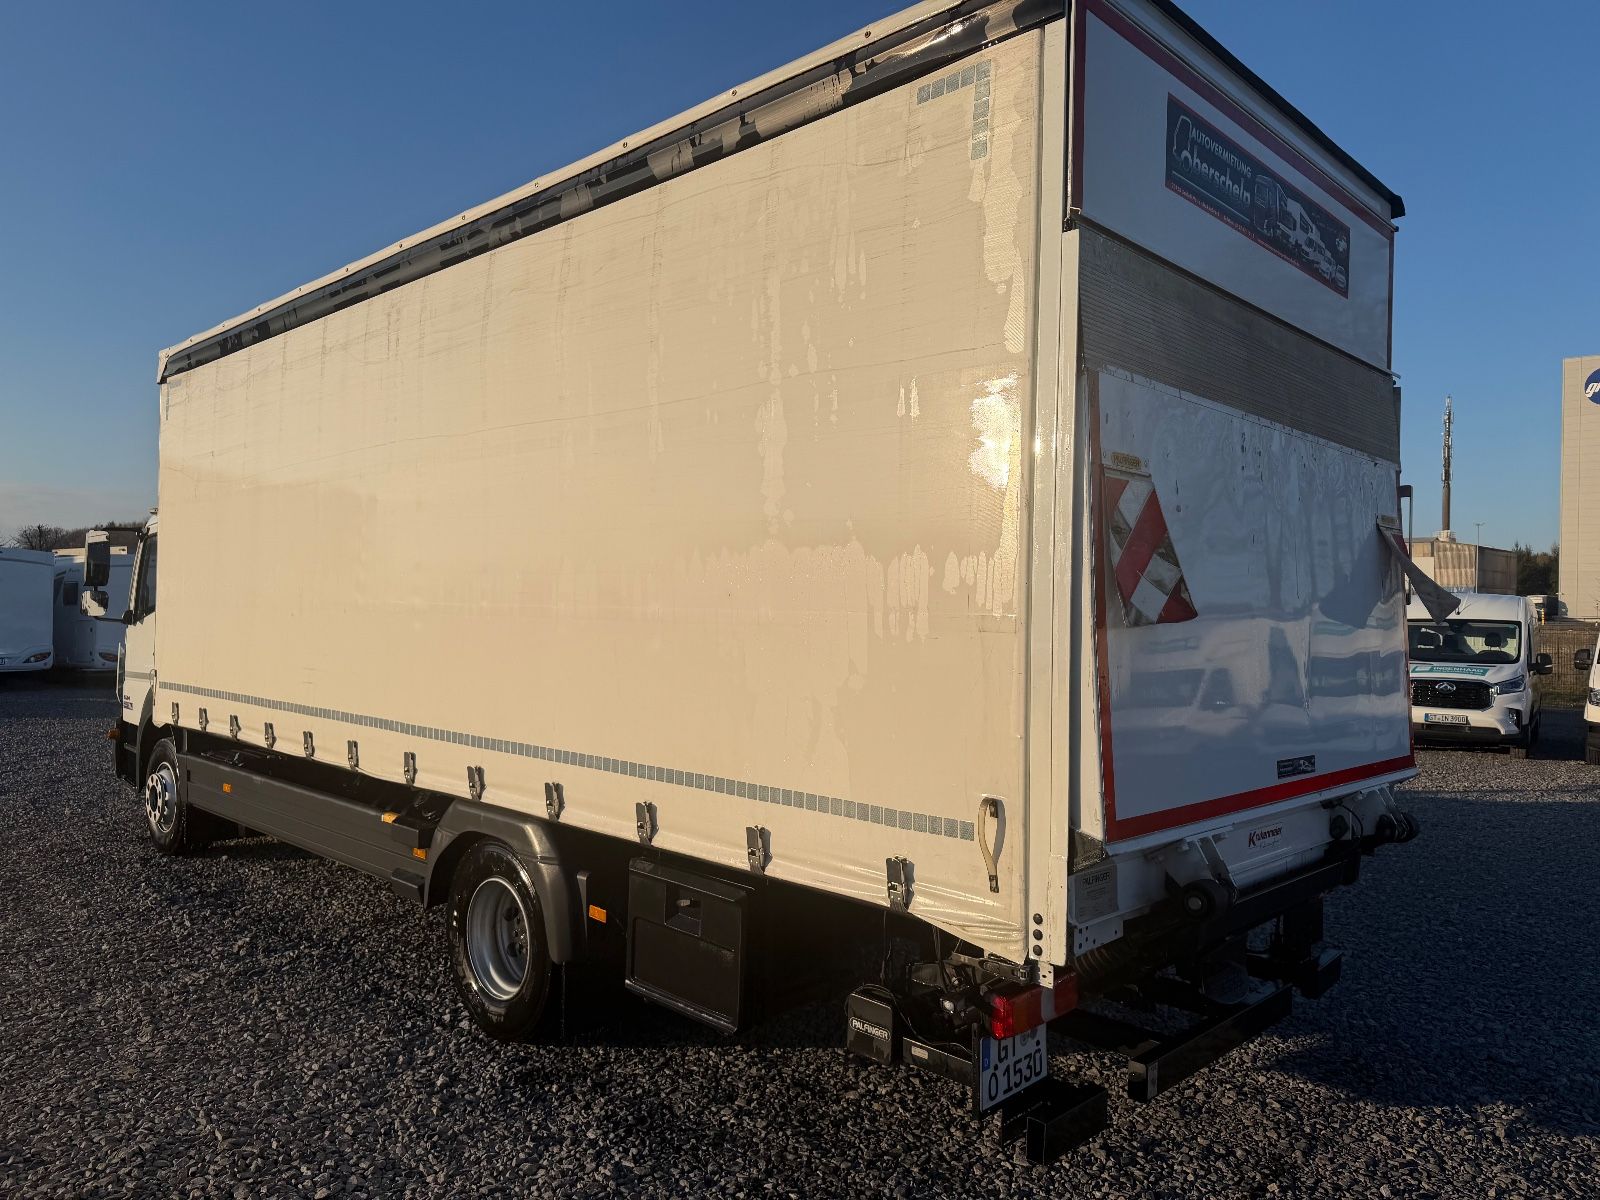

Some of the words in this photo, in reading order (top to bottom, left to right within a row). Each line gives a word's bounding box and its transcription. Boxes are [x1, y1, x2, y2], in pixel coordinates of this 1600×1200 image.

[1190, 127, 1252, 178] AUTOVERMIETUNG
[852, 1019, 888, 1040] PALFINGER
[1002, 1048, 1042, 1095] 1530
